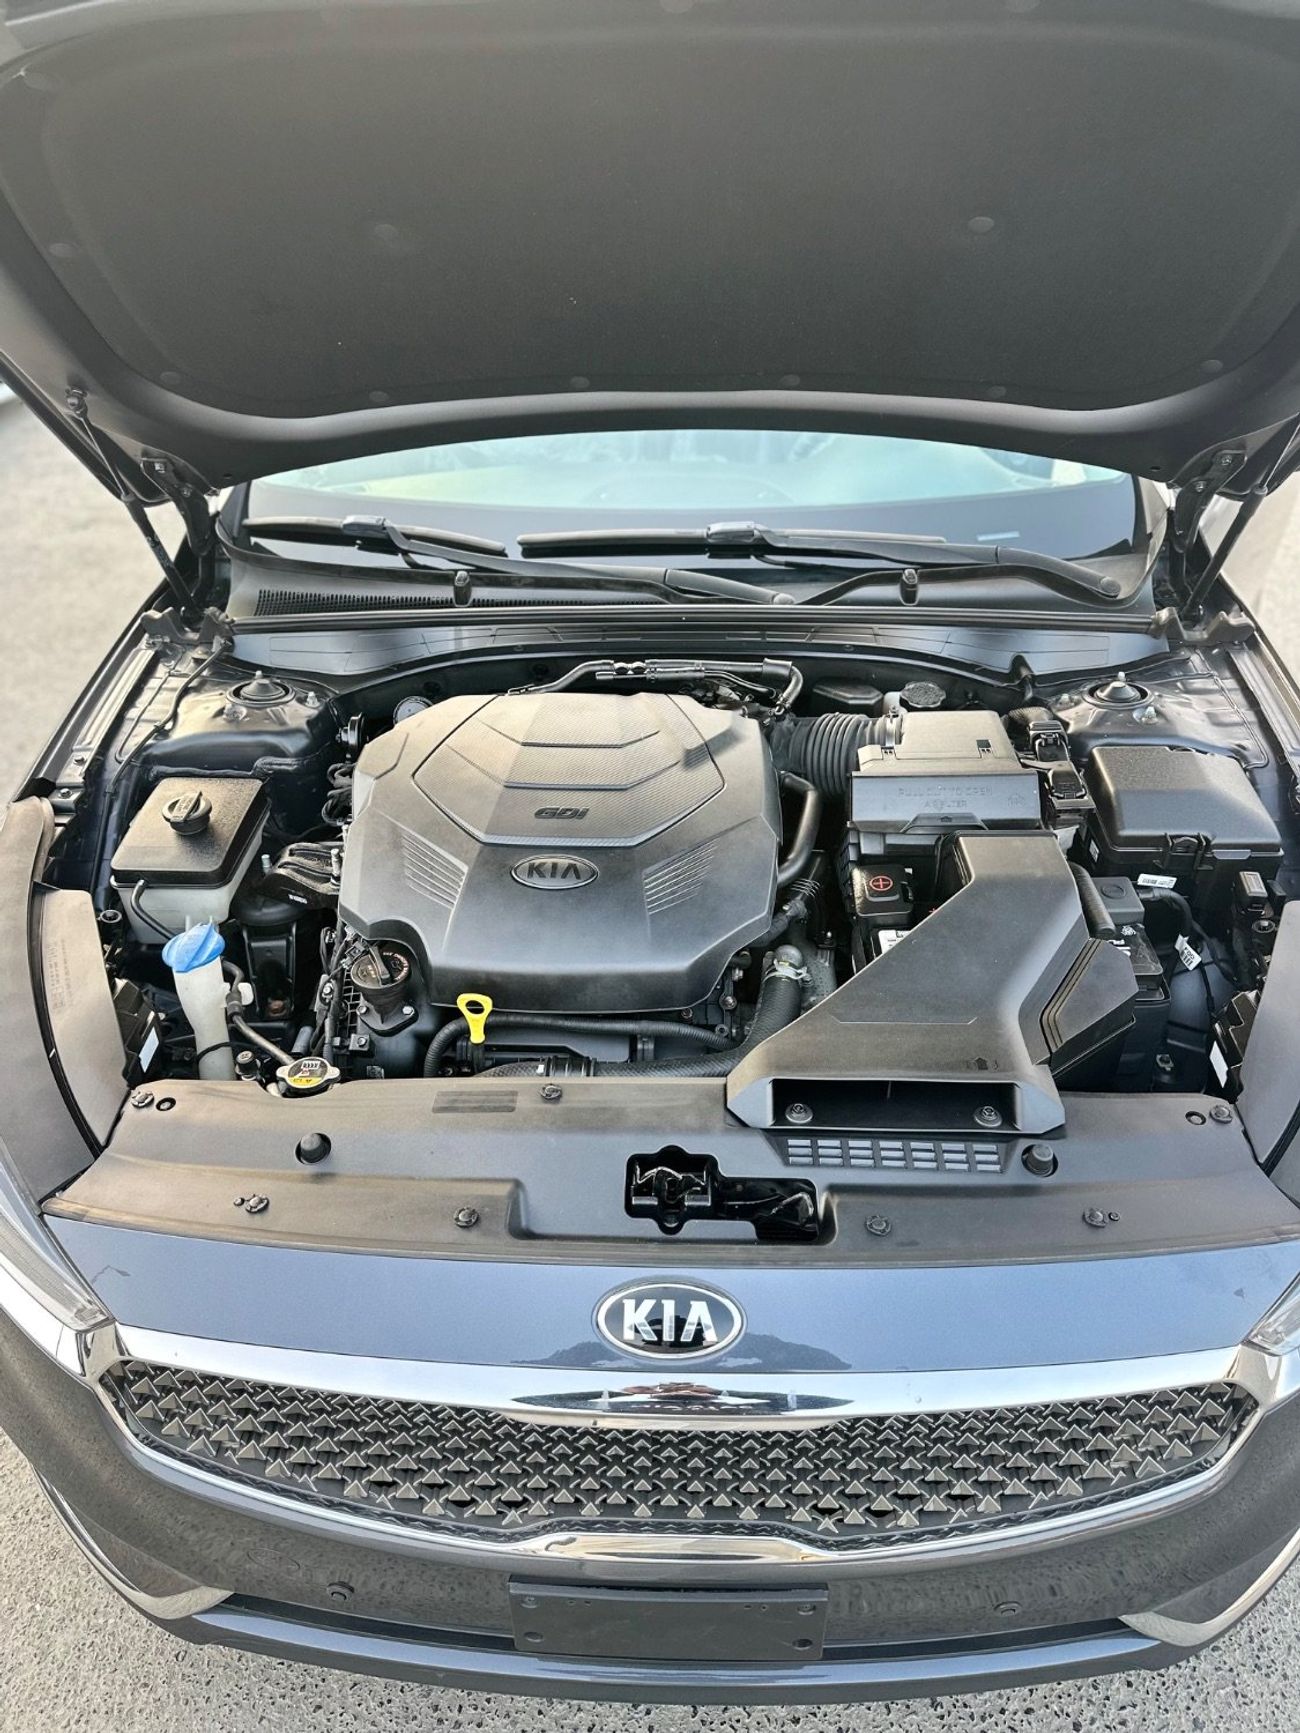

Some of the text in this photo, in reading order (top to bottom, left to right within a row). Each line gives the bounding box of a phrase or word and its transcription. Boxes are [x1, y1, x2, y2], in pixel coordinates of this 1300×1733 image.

[534, 806, 590, 820] GDI
[527, 861, 581, 880] KIA
[622, 1298, 718, 1342] KIA
